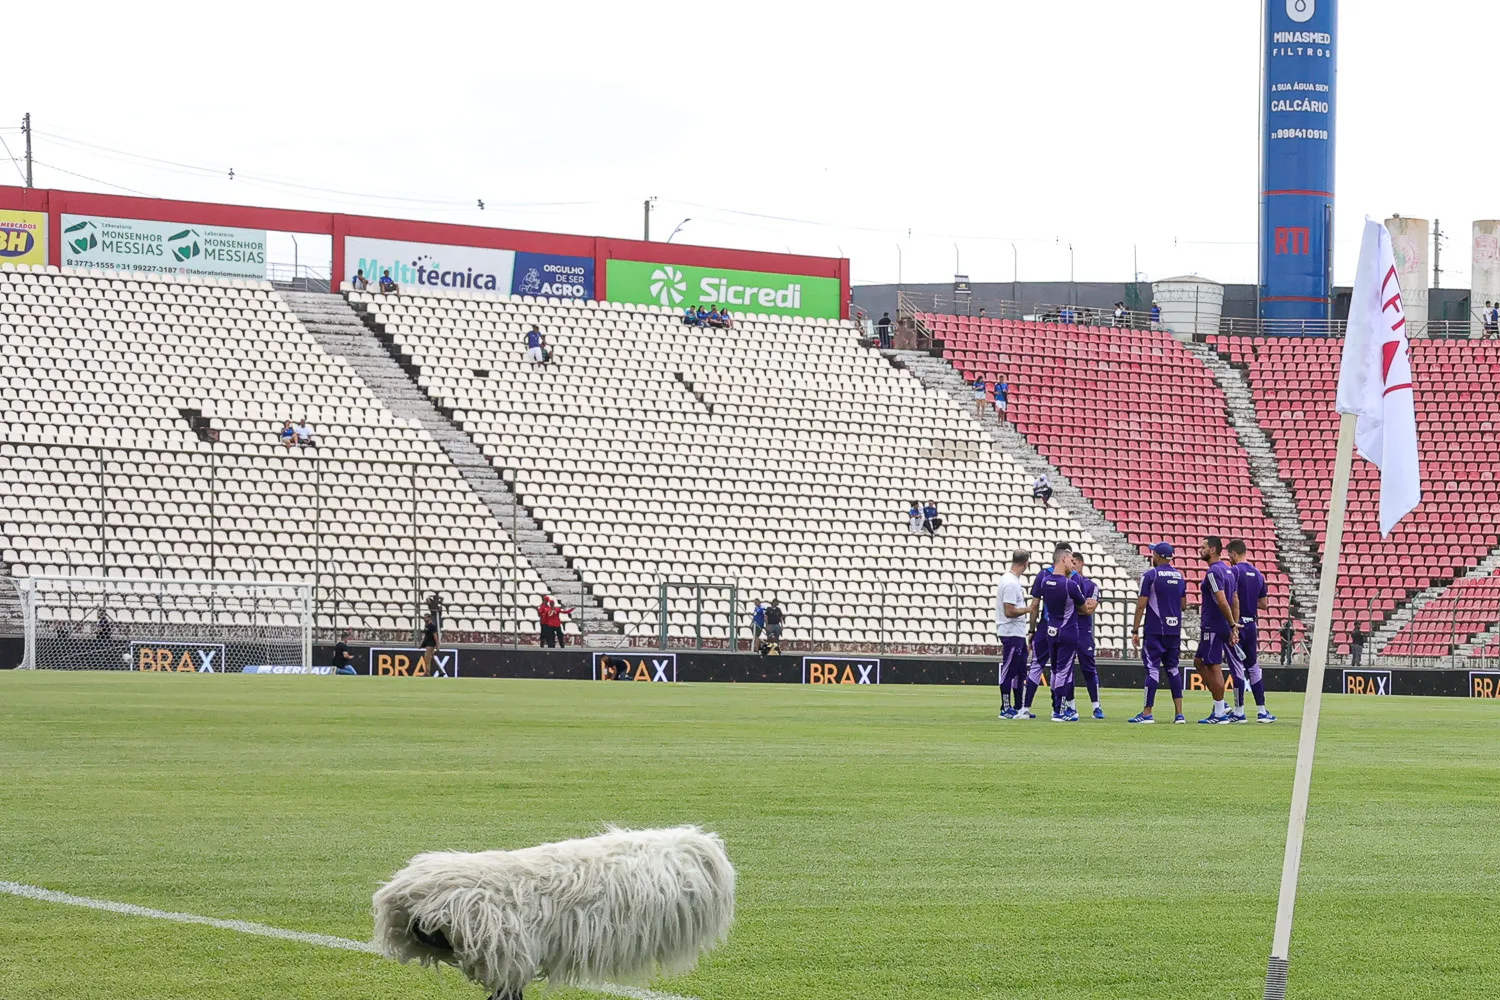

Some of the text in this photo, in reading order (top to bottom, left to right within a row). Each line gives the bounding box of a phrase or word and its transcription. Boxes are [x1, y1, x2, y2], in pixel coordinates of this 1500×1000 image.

[1273, 31, 1331, 44] MINASMED
[1272, 47, 1331, 58] FILTROS
[1277, 83, 1292, 91] SUA
[1293, 81, 1315, 91] ÁGUA
[1315, 83, 1329, 92] SEM
[1271, 97, 1329, 113] CALCÁRIO
[101, 230, 163, 242] MONSENHOR
[101, 240, 164, 257] MESSIAS
[204, 238, 264, 250] MONSENHOR
[204, 248, 265, 264] MESSIAS
[73, 260, 115, 269] 3773-1555
[132, 264, 178, 274] 99227-3187
[543, 264, 585, 275] ORGULHO
[555, 274, 585, 284] DE SER
[540, 282, 585, 298] AGRO
[699, 276, 802, 309] Sicredi
[140, 648, 216, 673] BRAX
[810, 664, 872, 685] BRAX
[1347, 675, 1387, 696] BRAX
